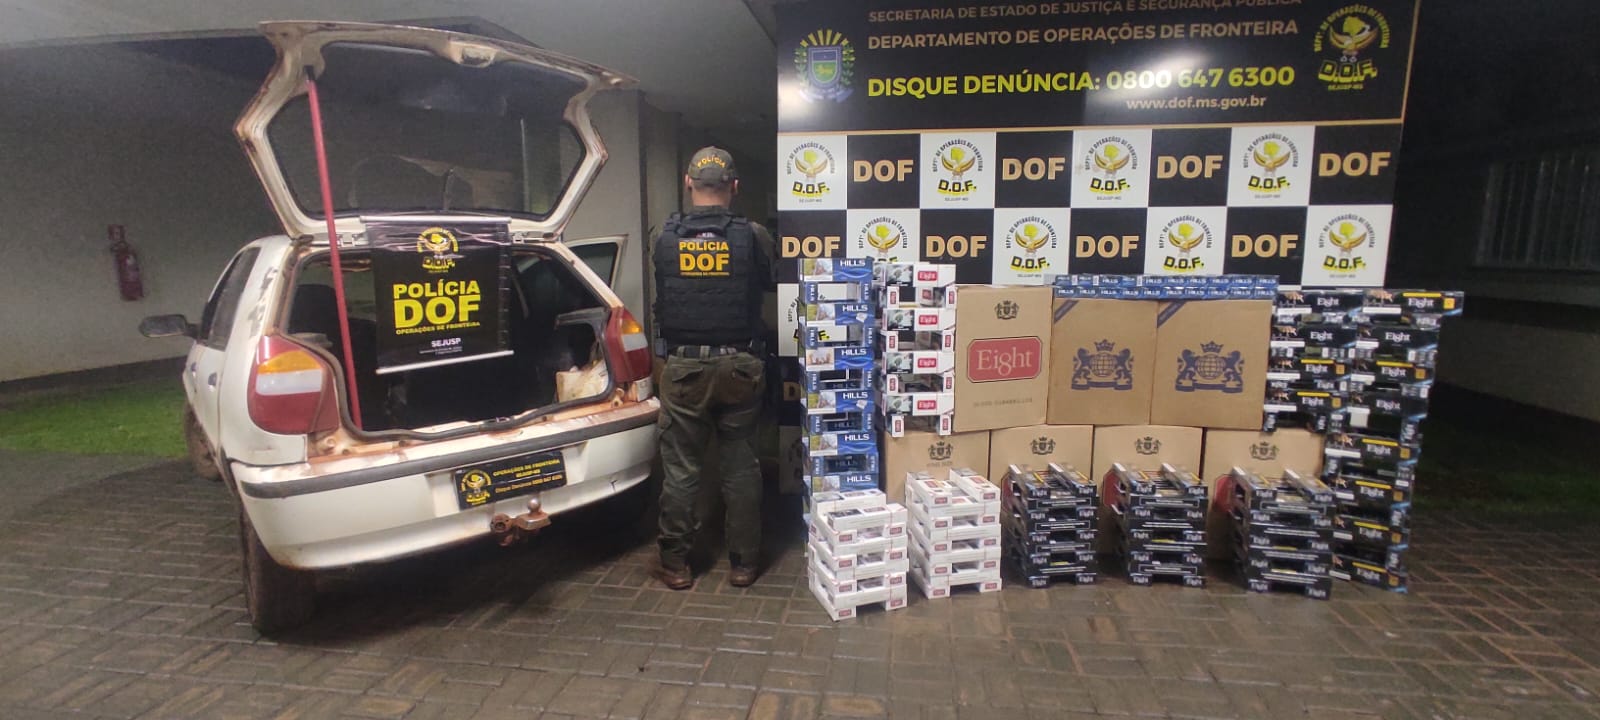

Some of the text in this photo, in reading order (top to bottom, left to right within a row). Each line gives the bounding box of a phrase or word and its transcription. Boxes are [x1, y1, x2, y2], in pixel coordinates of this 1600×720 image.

[868, 8, 954, 22] SECRETARIA
[957, 6, 978, 19] DE
[979, 3, 1037, 18] ESTADO
[1039, 1, 1060, 15] DE
[1063, 0, 1123, 15] JUSTIÇA
[1126, 0, 1136, 11] E
[1139, 0, 1236, 11] SEGURANÇA
[868, 20, 1299, 50] DEPARTAMENTO DE OPERAÇÕES DE FRONTEIRA
[868, 75, 958, 99] DISQUE
[963, 69, 1100, 95] DENÚNCIA:
[1106, 69, 1173, 91] 0800
[1177, 67, 1224, 88] 647
[1228, 66, 1295, 88] 6300
[1126, 96, 1267, 111] www.dof.ms.gov.br
[697, 155, 726, 168] POLÍCIA
[1156, 154, 1224, 179] DOF
[1318, 151, 1391, 177] DOF
[853, 159, 914, 183] DOF
[1002, 157, 1066, 181] DOF
[938, 179, 977, 192] D.O.F.
[1090, 177, 1131, 191] D.O.F.
[1248, 175, 1290, 189] D.O.F.
[792, 181, 830, 194] D.O.F.
[679, 240, 729, 251] POLÍCIA
[781, 236, 841, 259] DOF
[925, 235, 988, 258] DOF
[1075, 235, 1140, 259] DOF
[1231, 234, 1298, 258] DOF
[680, 253, 730, 271] DOF
[840, 259, 866, 267] HILLS
[1011, 256, 1050, 269] D.O.F.
[1164, 256, 1205, 269] D.O.F.
[1323, 255, 1366, 269] D.O.F.
[920, 272, 936, 280] Eight
[393, 279, 480, 299] POLÍCIA
[1317, 297, 1339, 307] Eight
[1408, 297, 1434, 308] Eight
[394, 294, 481, 329] DOF
[842, 304, 868, 312] HILLS
[920, 316, 937, 324] Eight
[1310, 331, 1333, 341] Eight
[1385, 332, 1411, 342] Eight
[431, 337, 461, 348] SEJUSP
[919, 359, 936, 367] Eight
[977, 347, 1033, 376] Eight
[1305, 364, 1328, 374] Eight
[1381, 367, 1407, 377] Eight
[919, 401, 935, 409] Eight
[1302, 397, 1324, 406] Eight
[1376, 400, 1400, 410] Eight
[1367, 444, 1391, 456] Eight
[846, 475, 872, 483] HILLS
[1031, 488, 1048, 497] Eight
[1078, 486, 1094, 495] Eight
[1136, 485, 1152, 495] Eight
[1188, 486, 1204, 496] Eight
[1256, 489, 1273, 498] Eight
[1360, 486, 1385, 498] Eight
[1314, 494, 1333, 502] Eight
[1031, 512, 1046, 520] Eight
[1079, 509, 1094, 518] Eight
[1134, 509, 1150, 518] Eight
[1187, 510, 1203, 519] Eight
[1252, 513, 1271, 521] Eight
[1314, 518, 1332, 527] Eight
[1079, 531, 1095, 540] Eight
[1133, 531, 1149, 540] Eight
[1186, 533, 1202, 542] Eight
[1359, 527, 1383, 539] Eight
[1031, 534, 1047, 543] Eight
[1252, 536, 1270, 545] Eight
[1311, 542, 1329, 550] Eight
[1032, 556, 1048, 565] Eight
[1079, 553, 1094, 562] Eight
[1133, 553, 1149, 562] Eight
[1186, 555, 1202, 564] Eight
[1251, 559, 1268, 568] Eight
[1307, 565, 1326, 573] Eight
[1079, 574, 1094, 584] Eight
[1133, 575, 1149, 584] Eight
[1356, 568, 1381, 581] Eight
[1031, 579, 1047, 587] Eight
[1186, 578, 1202, 586] Eight
[1251, 582, 1268, 591] Eight
[1308, 588, 1326, 598] Eight
